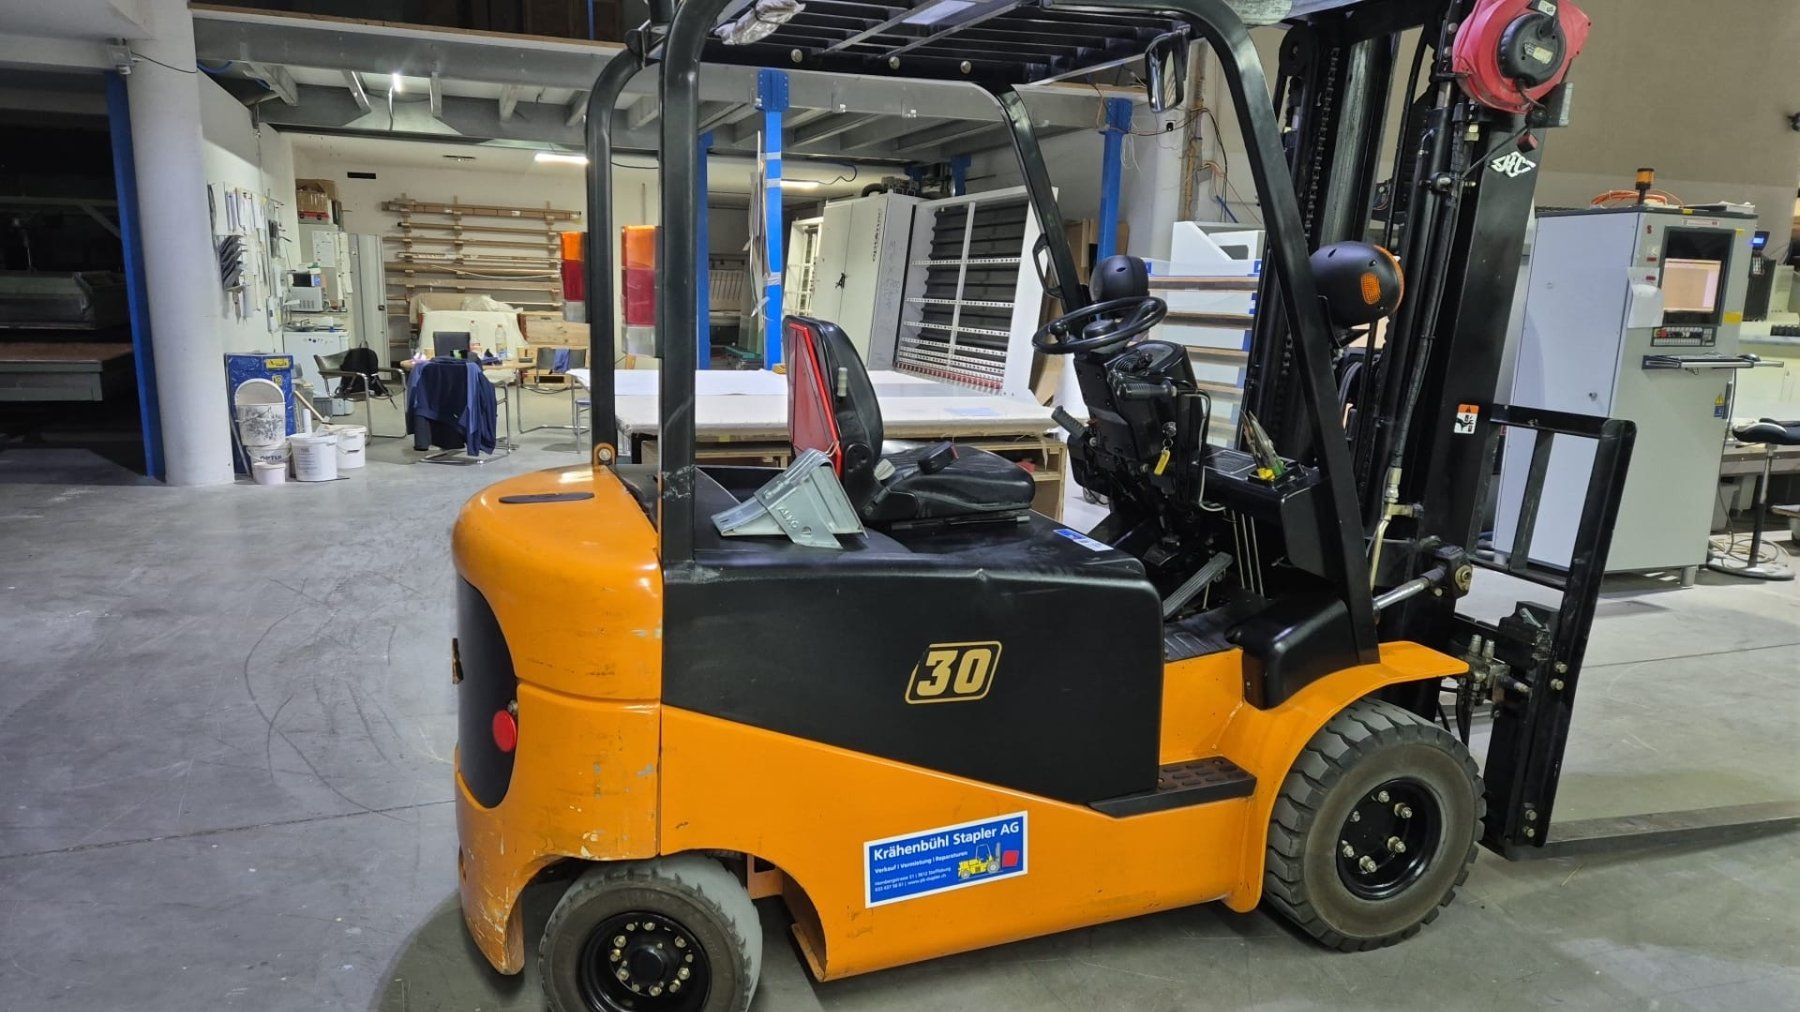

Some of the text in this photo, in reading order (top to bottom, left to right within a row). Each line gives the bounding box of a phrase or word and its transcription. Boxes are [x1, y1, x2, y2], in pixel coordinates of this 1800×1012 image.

[917, 649, 992, 696] 30
[874, 821, 1019, 861] Krähenbühl Stapler AG
[875, 851, 968, 874] Verkauf Vermietung Reparaturen
